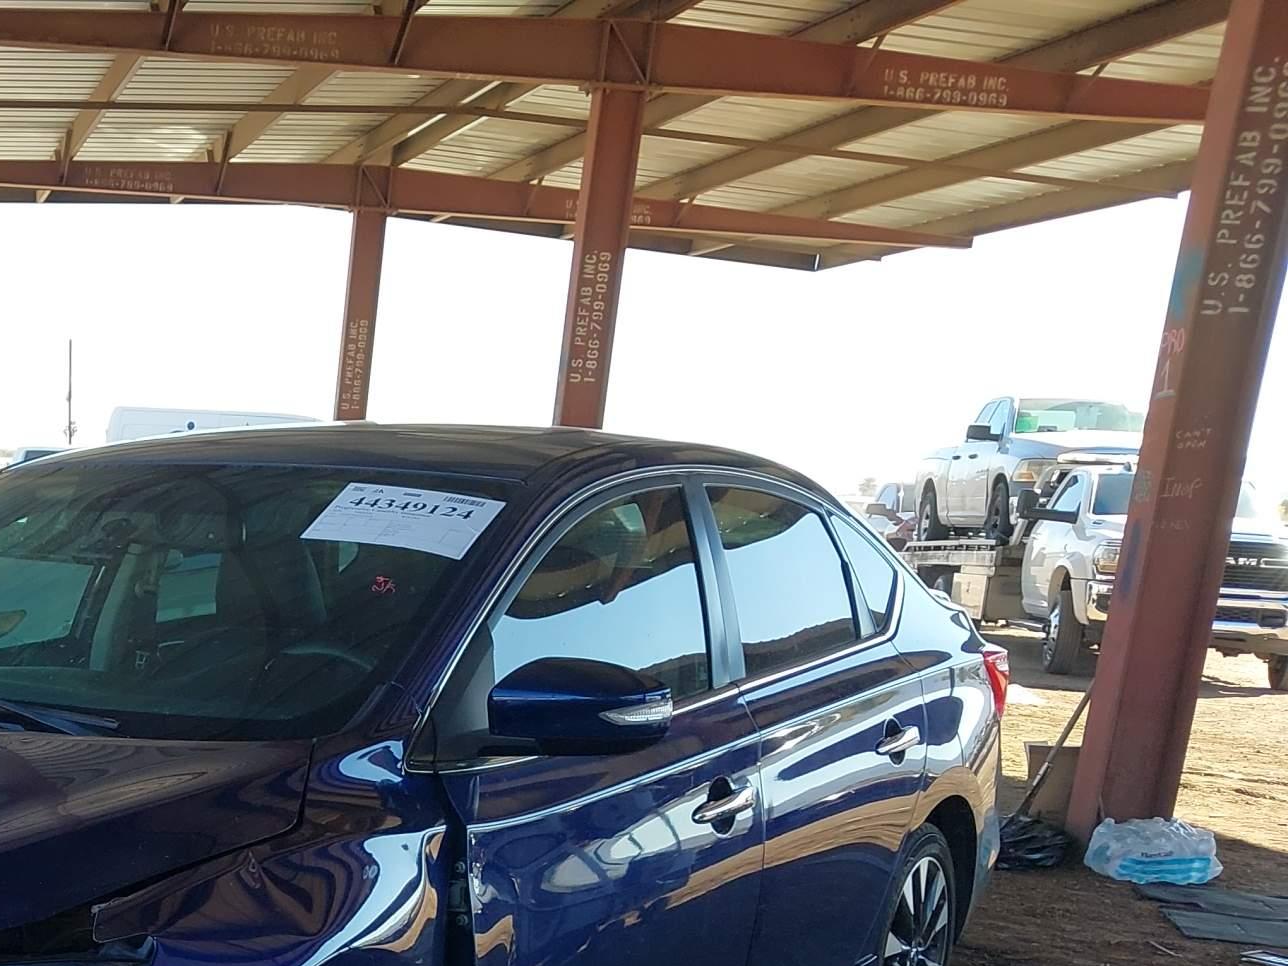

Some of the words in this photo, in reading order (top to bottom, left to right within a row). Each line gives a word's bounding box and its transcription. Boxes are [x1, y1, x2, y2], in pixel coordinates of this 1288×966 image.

[883, 84, 1009, 107] 1-866-799-0969
[919, 71, 977, 89] PREFAB
[983, 75, 1010, 92] INC.
[1245, 56, 1280, 113] INC.
[1215, 130, 1261, 245] PREFAB
[574, 287, 593, 346] PREFAB
[584, 249, 598, 279] INC.
[583, 251, 612, 383] 1-866-799-0969
[1200, 263, 1232, 316] U.S.
[349, 496, 475, 520] 44349124
